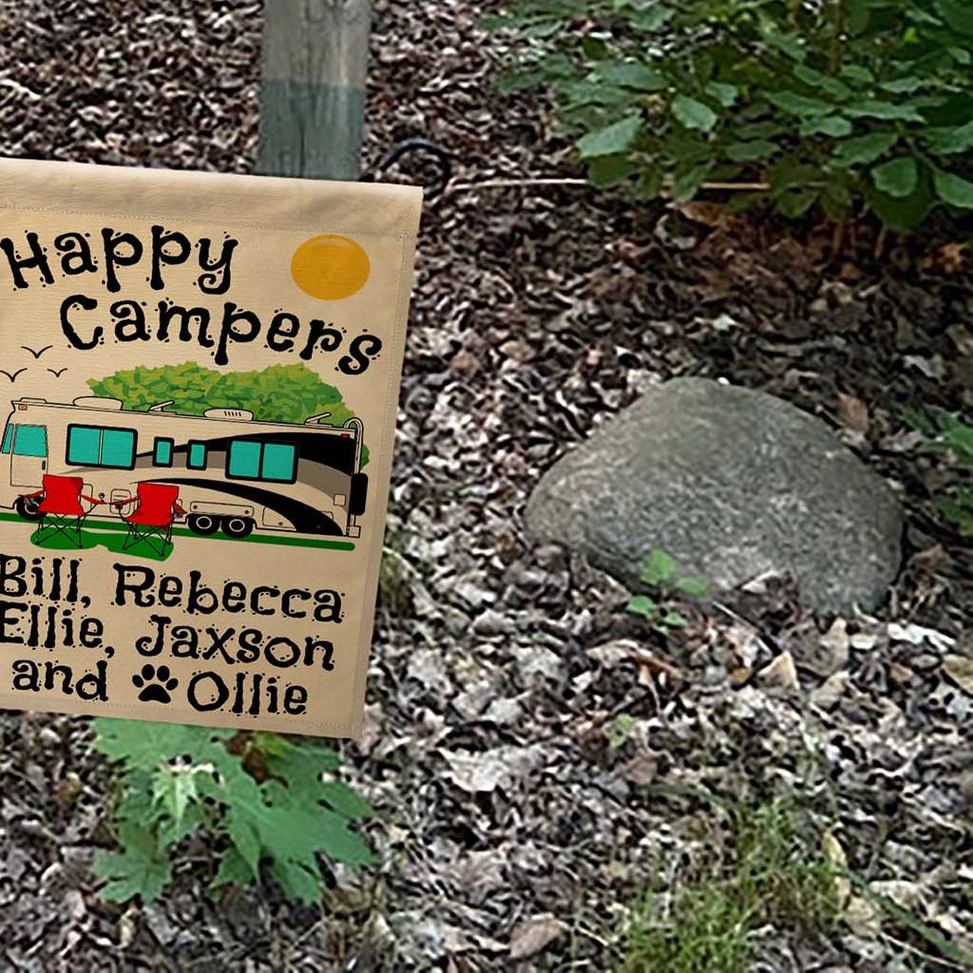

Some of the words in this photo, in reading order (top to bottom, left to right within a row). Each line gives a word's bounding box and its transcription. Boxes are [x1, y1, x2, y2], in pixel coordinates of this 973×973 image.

[0, 225, 239, 293] Happy
[59, 294, 382, 377] Campers
[112, 563, 346, 625] Rebecca
[134, 615, 335, 672] Jaxson
[11, 656, 109, 703] and
[186, 670, 309, 717] Ollie
